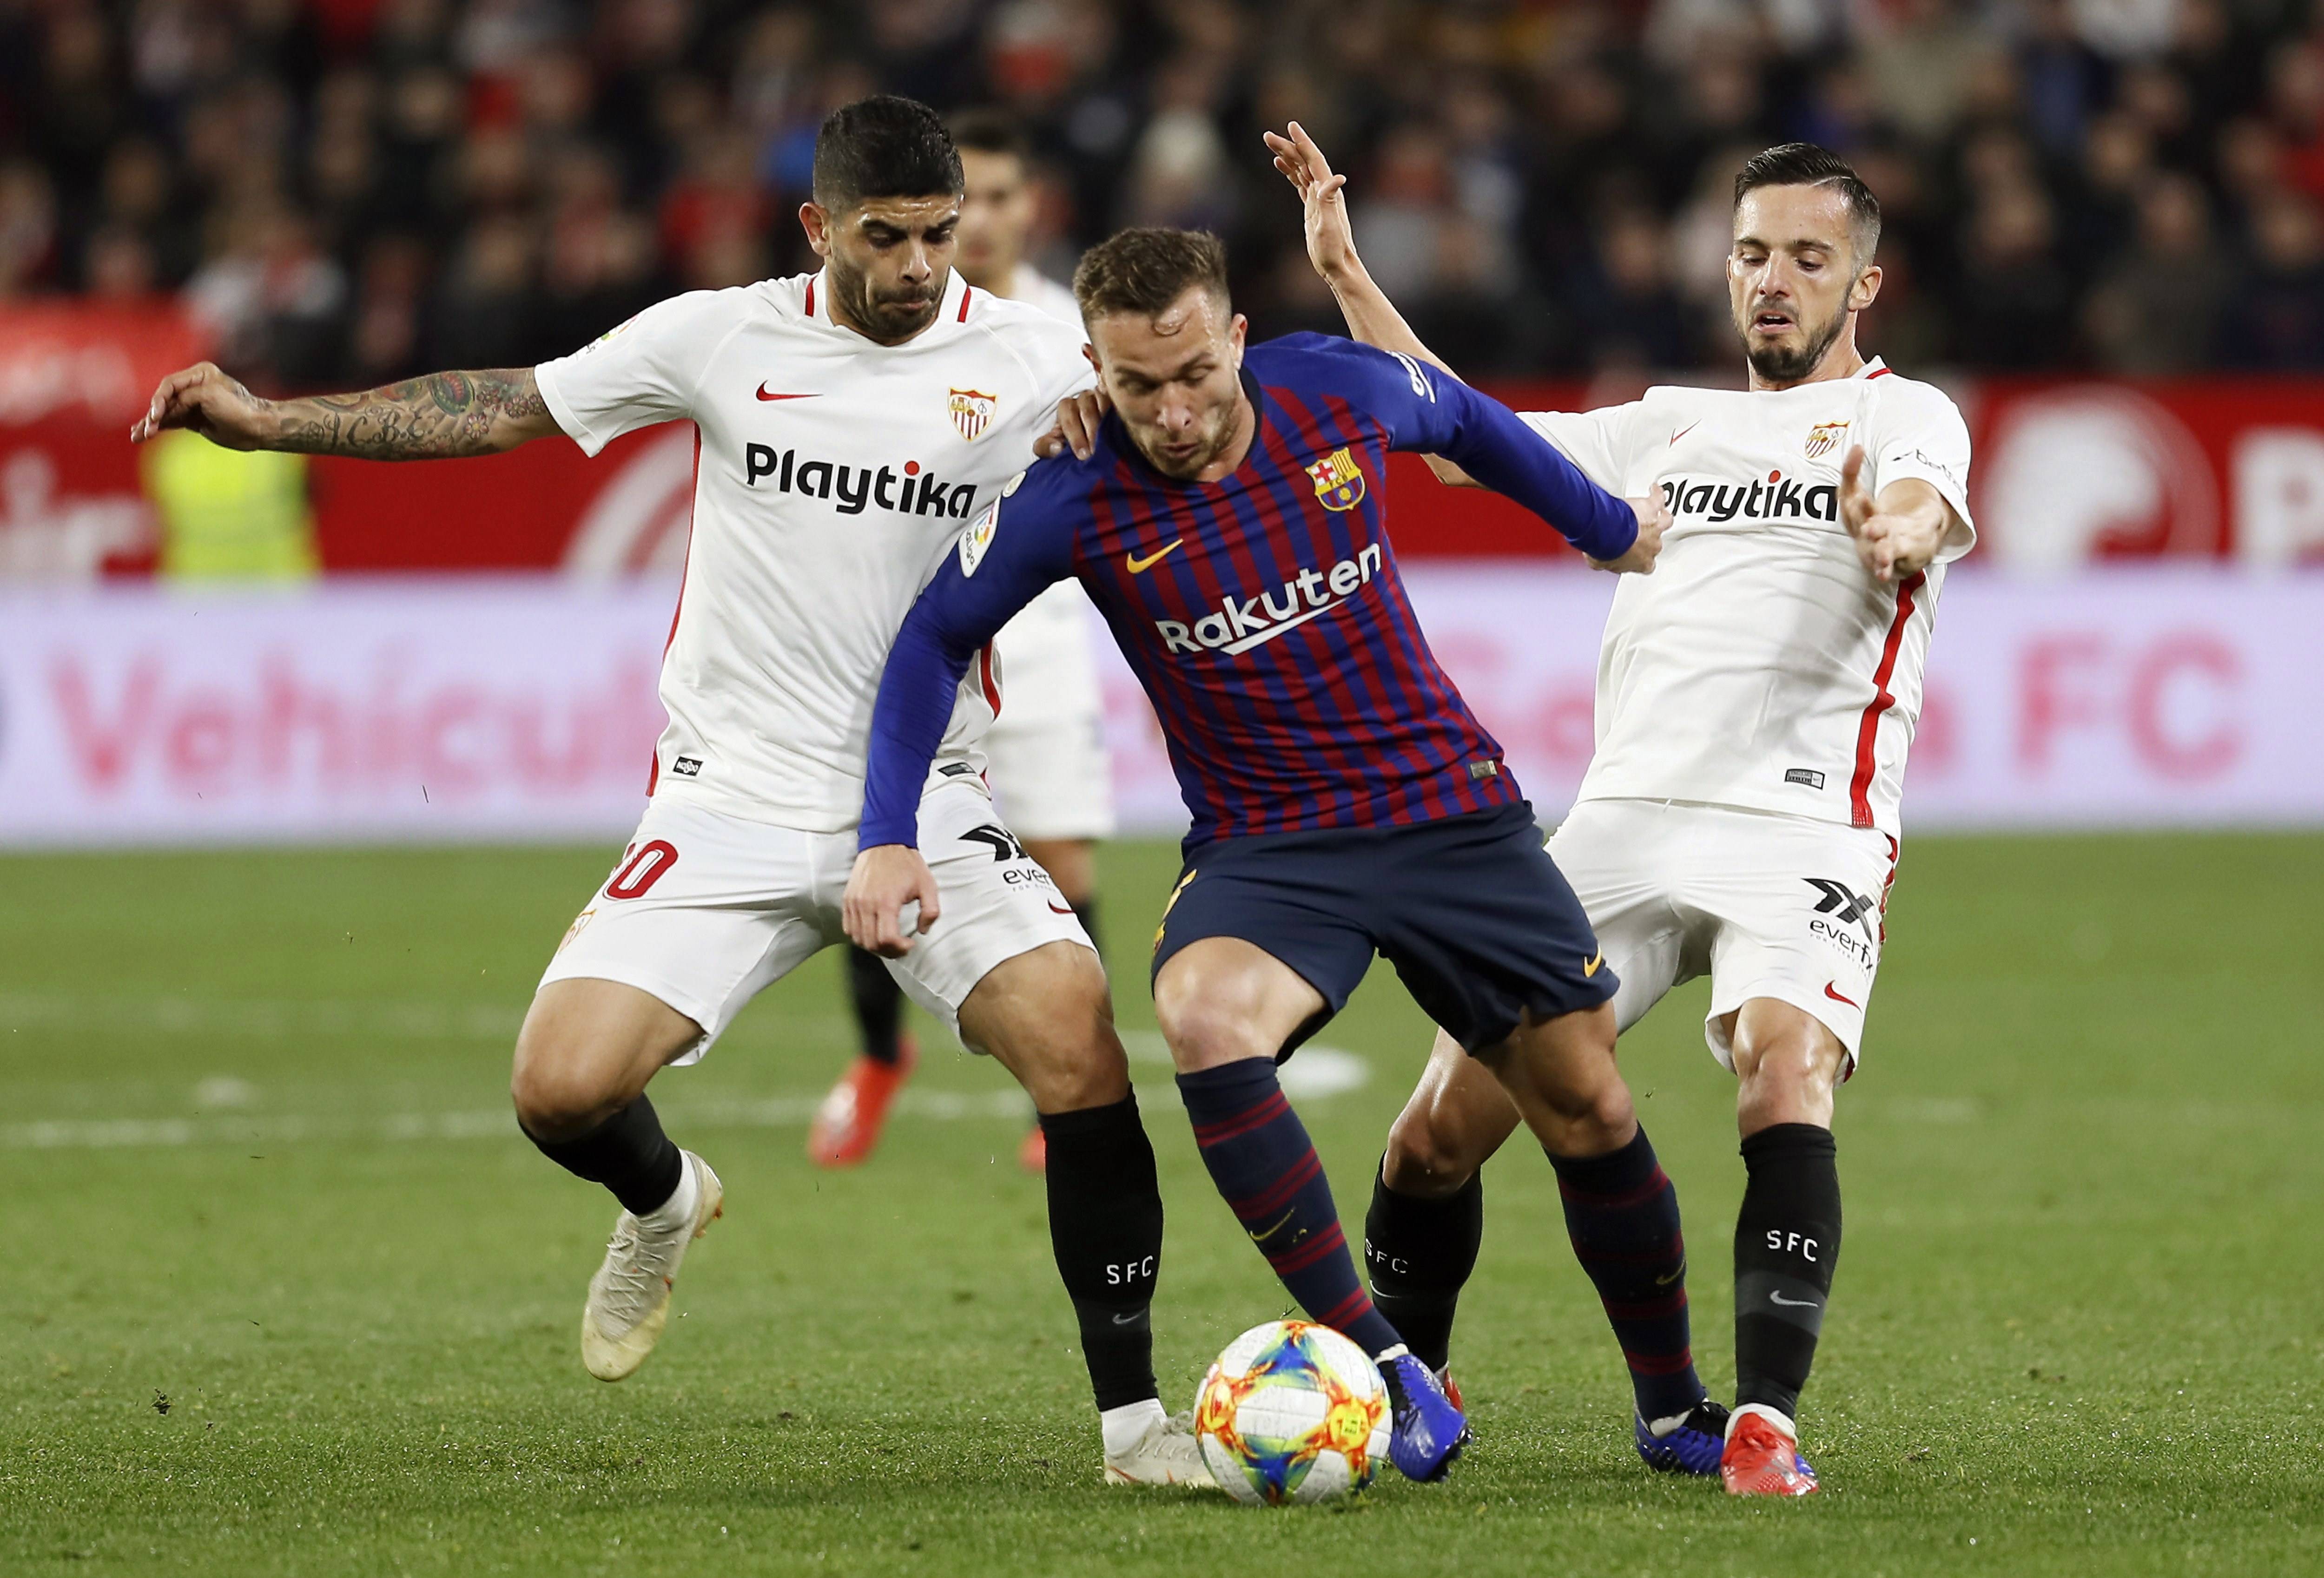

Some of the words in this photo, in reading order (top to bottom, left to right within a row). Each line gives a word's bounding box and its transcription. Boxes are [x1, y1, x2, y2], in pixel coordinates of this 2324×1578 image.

[746, 442, 978, 519] Playtika
[1155, 543, 1382, 654] Rakuten
[1106, 1255, 1153, 1285] SFC
[1766, 1230, 1818, 1262] SFC
